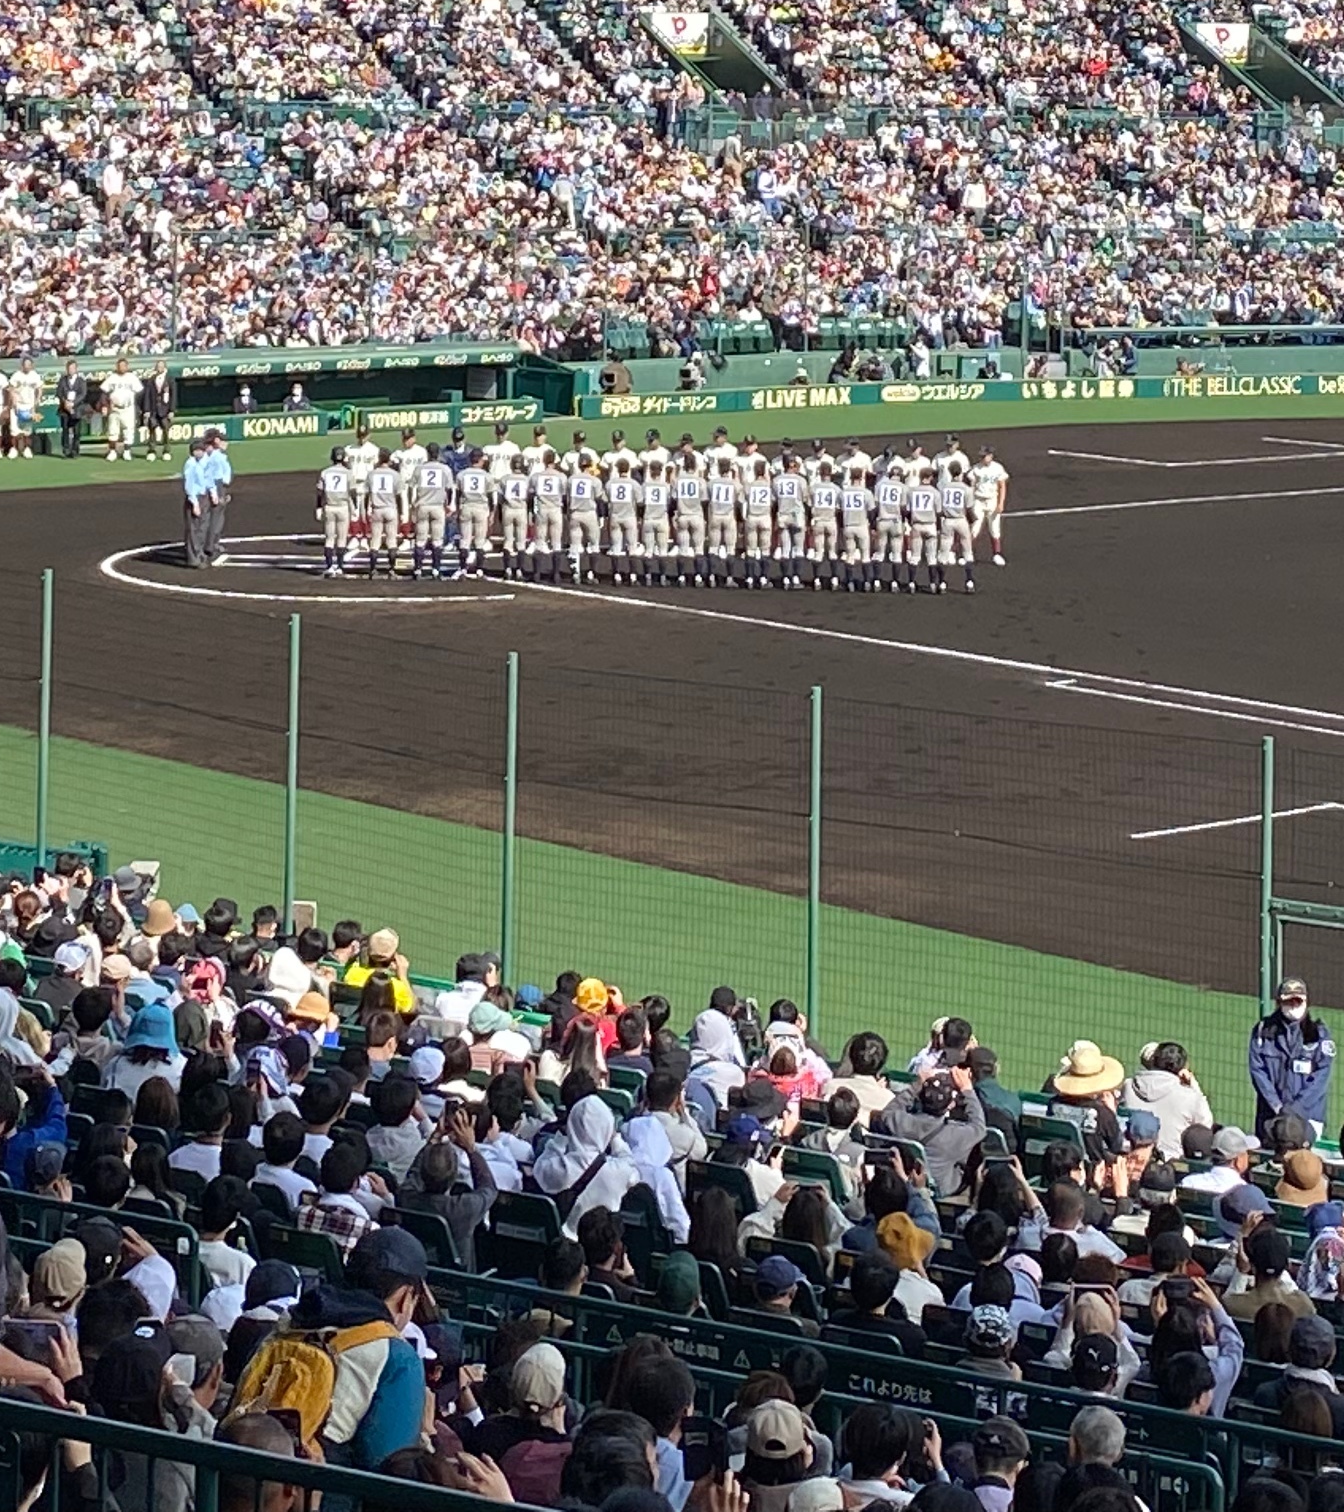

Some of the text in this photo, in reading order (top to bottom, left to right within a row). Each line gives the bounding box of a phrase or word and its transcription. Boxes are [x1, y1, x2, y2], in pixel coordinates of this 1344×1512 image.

[1022, 379, 1135, 399] いちよし証券
[1171, 376, 1202, 396] THE
[460, 404, 538, 423] コナミグループ
[243, 414, 319, 437] KONAMI
[378, 477, 387, 491] 1
[426, 472, 437, 487] 2
[469, 476, 479, 490] 3
[543, 478, 553, 492] 5
[575, 481, 585, 495] 6
[616, 486, 625, 500] 8
[680, 481, 696, 496] 10
[715, 484, 730, 501] 11
[779, 481, 795, 495] 13
[651, 489, 660, 503] 9
[751, 489, 768, 504] 12
[816, 491, 833, 506] 14
[845, 494, 862, 508] 15
[881, 489, 898, 502] 16
[912, 494, 930, 508] 17
[945, 491, 963, 505] 18
[849, 1373, 933, 1404] これより先は
